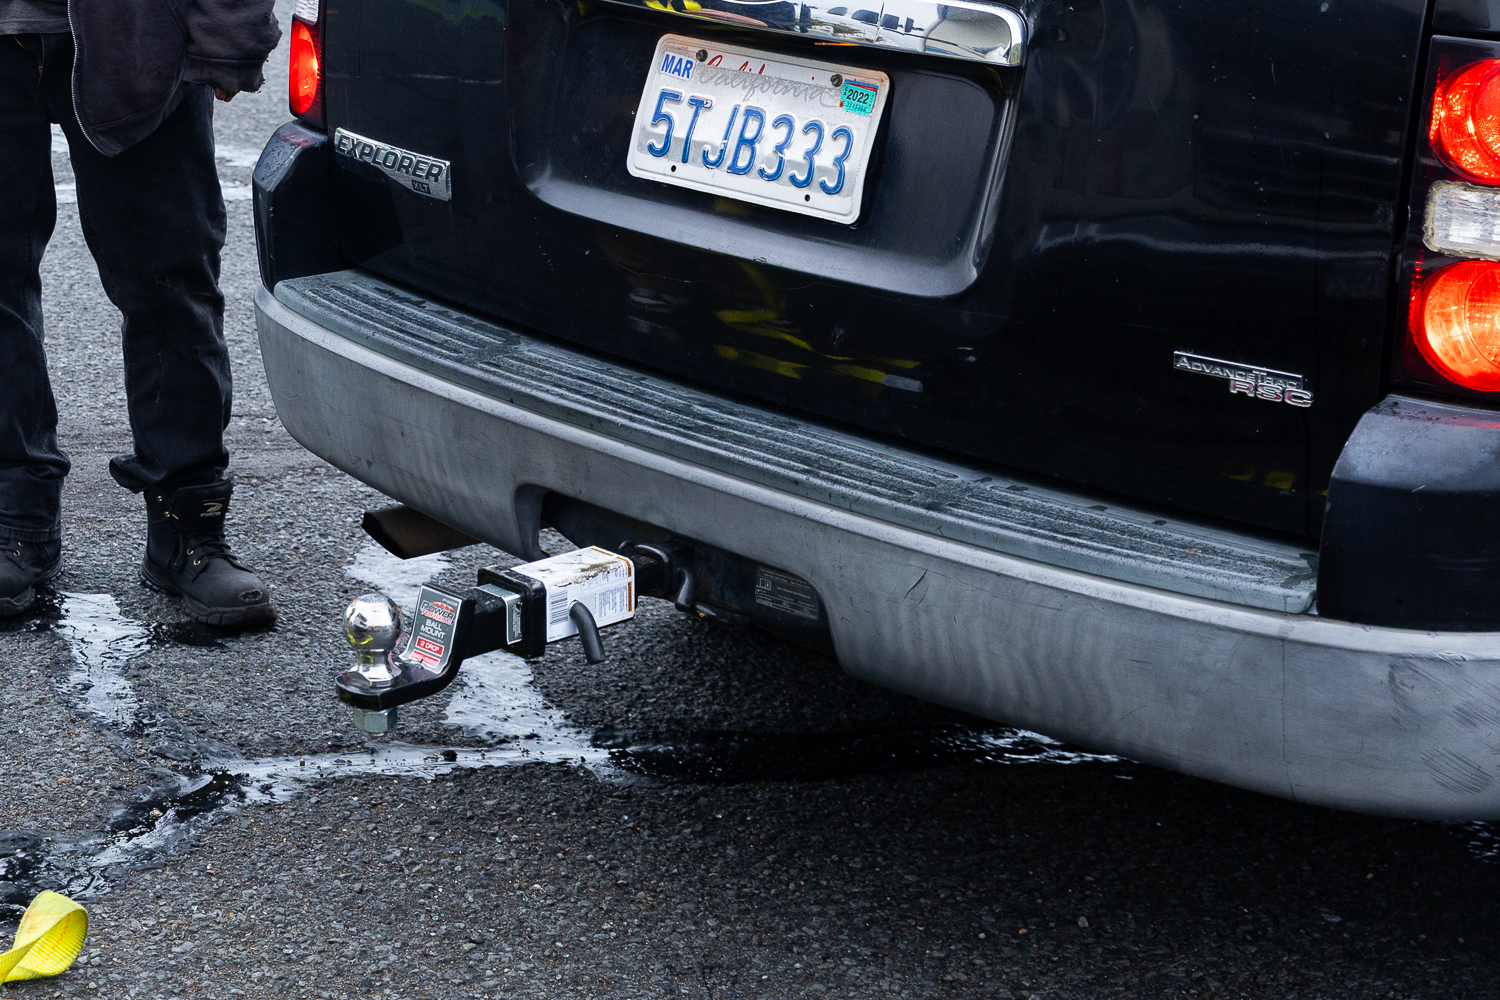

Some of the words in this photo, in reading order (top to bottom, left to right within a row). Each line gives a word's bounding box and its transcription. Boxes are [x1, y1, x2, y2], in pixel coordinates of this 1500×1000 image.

[661, 53, 695, 79] MAR
[847, 88, 870, 105] 2022
[647, 88, 855, 196] 5TJB333
[336, 132, 447, 183] EXPLORER
[412, 180, 430, 194] XLT
[1229, 379, 1314, 408] RSC
[420, 600, 455, 620] POWER
[420, 624, 446, 639] MOUNT
[425, 618, 443, 631] BALL
